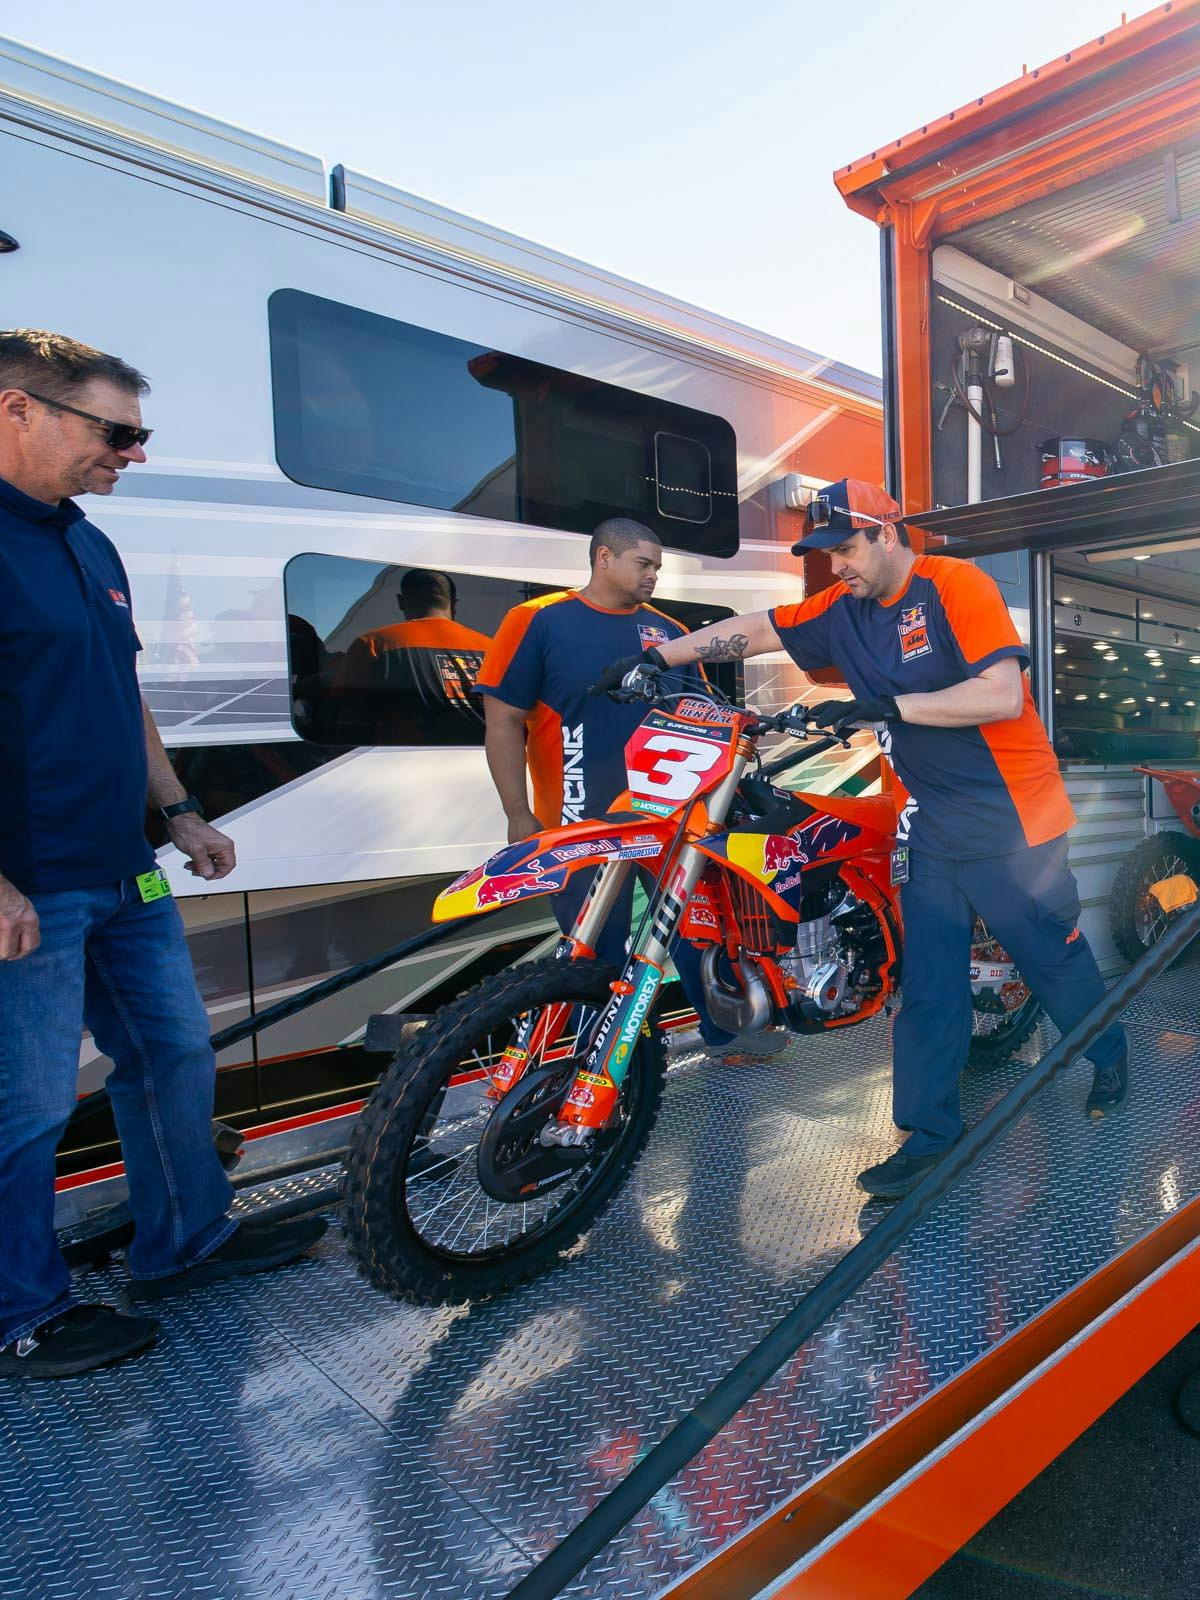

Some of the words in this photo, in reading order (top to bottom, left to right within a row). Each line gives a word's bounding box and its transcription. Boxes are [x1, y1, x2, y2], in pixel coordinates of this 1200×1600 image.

[667, 722, 708, 734] SUPERCROSS
[561, 722, 584, 826] ACING
[627, 735, 723, 801] 3
[639, 802, 671, 815] MOTOREX
[551, 843, 585, 862] Red
[583, 839, 616, 857] Bull
[618, 846, 661, 859] PROGRESSIVE
[594, 965, 634, 1050] DUNLP
[621, 975, 659, 1043] MOTOREX
